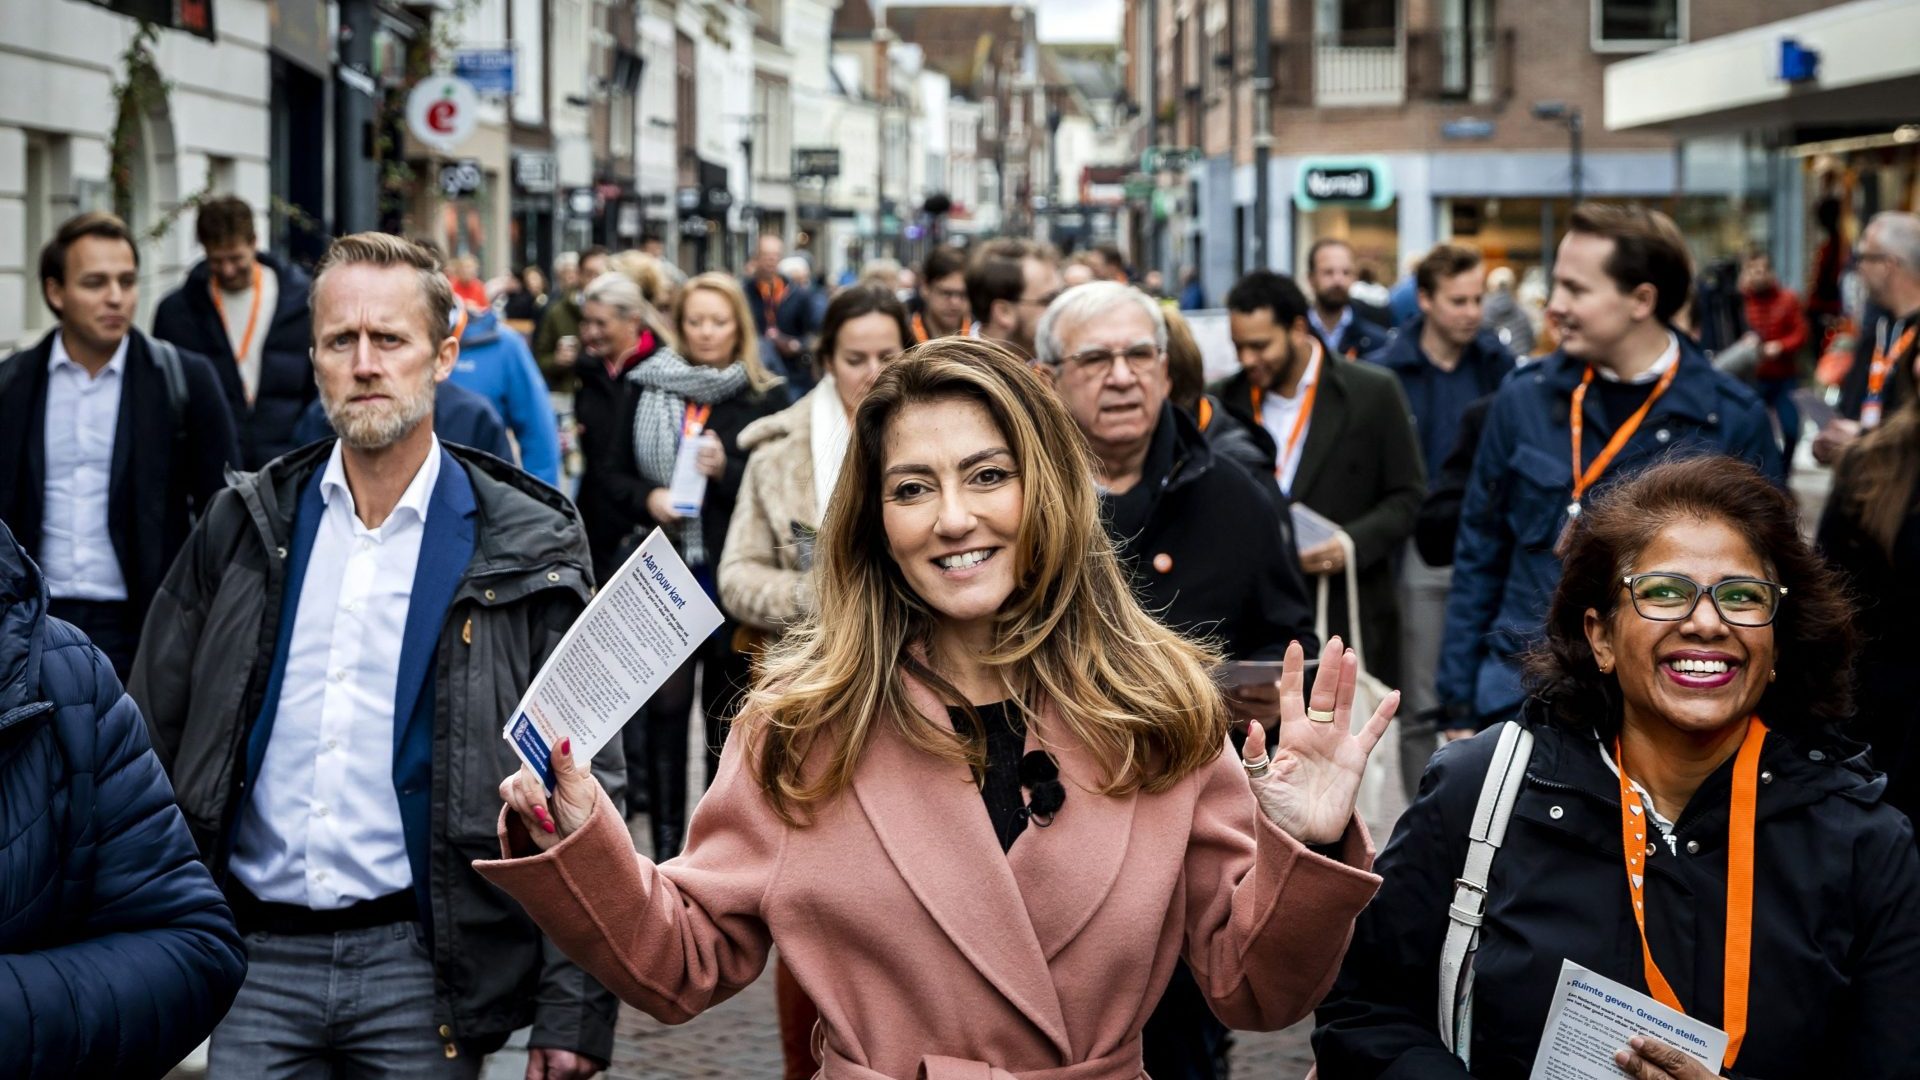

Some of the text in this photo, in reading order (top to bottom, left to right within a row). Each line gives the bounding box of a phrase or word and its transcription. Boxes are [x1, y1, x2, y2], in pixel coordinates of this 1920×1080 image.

[643, 555, 686, 610] Aan jouw kant
[1571, 980, 1707, 1048] Ruimte geven. Grenzen stellen.
